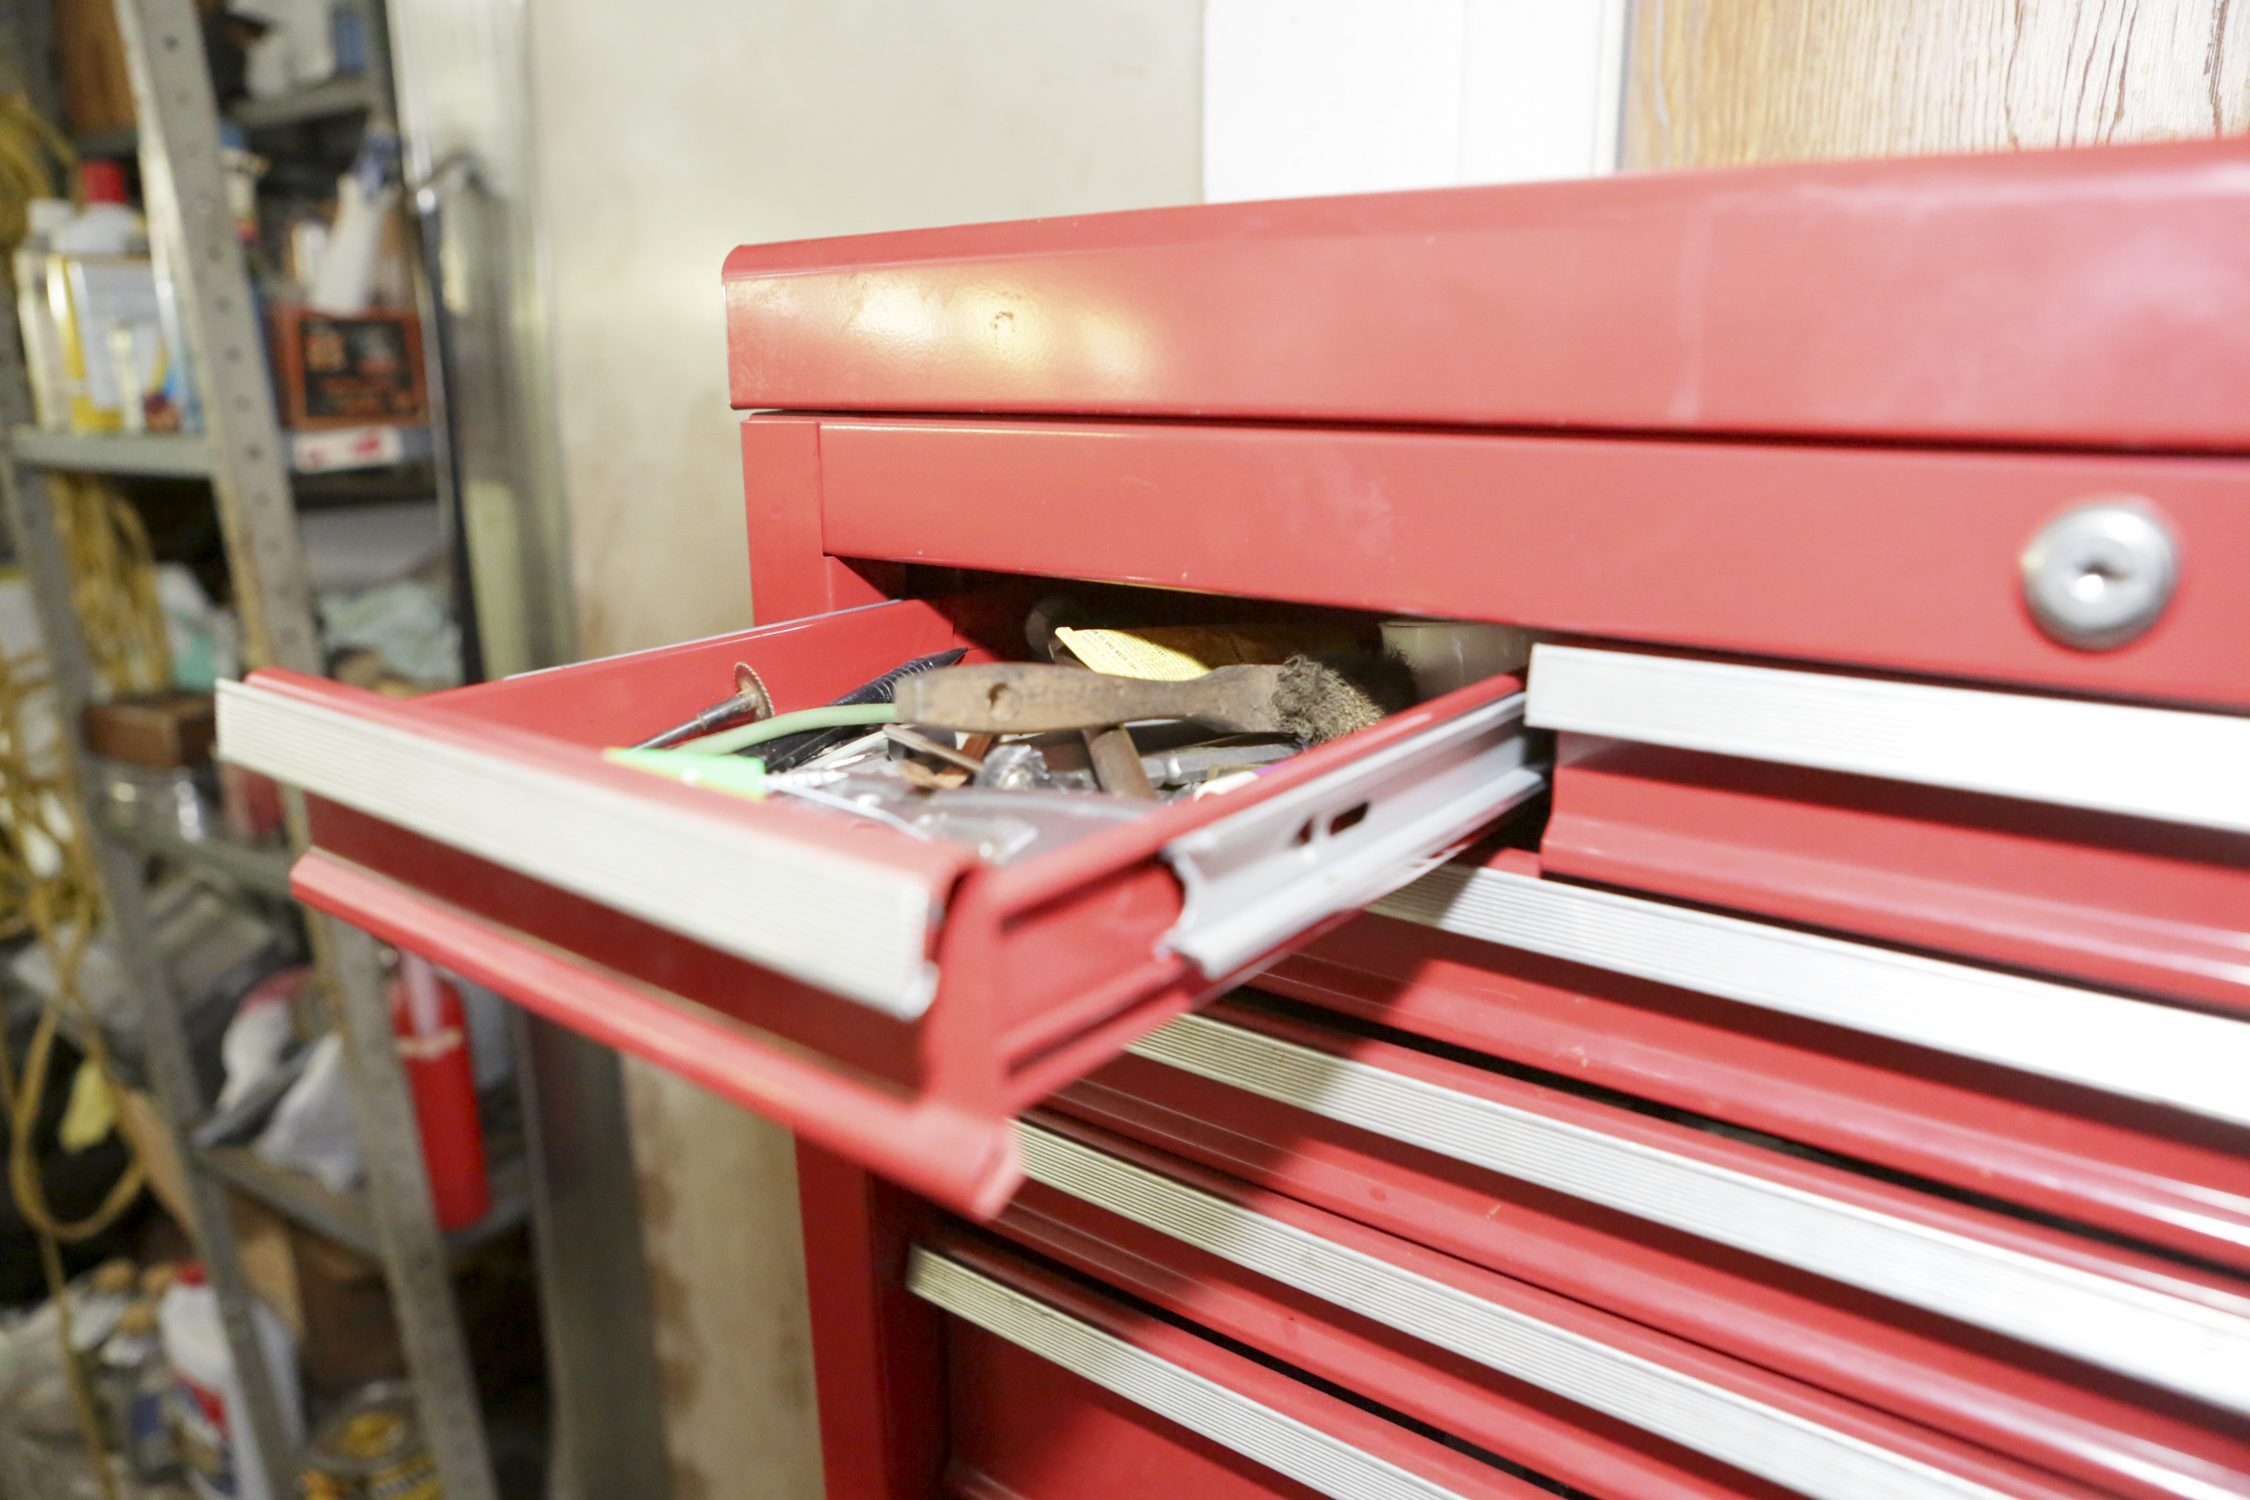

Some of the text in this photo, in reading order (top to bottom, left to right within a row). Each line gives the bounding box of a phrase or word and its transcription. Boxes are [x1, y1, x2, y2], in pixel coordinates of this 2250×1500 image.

[1105, 641, 1115, 650] AND
[1115, 650, 1128, 661] WATER
[1127, 661, 1139, 671] LEAKS
